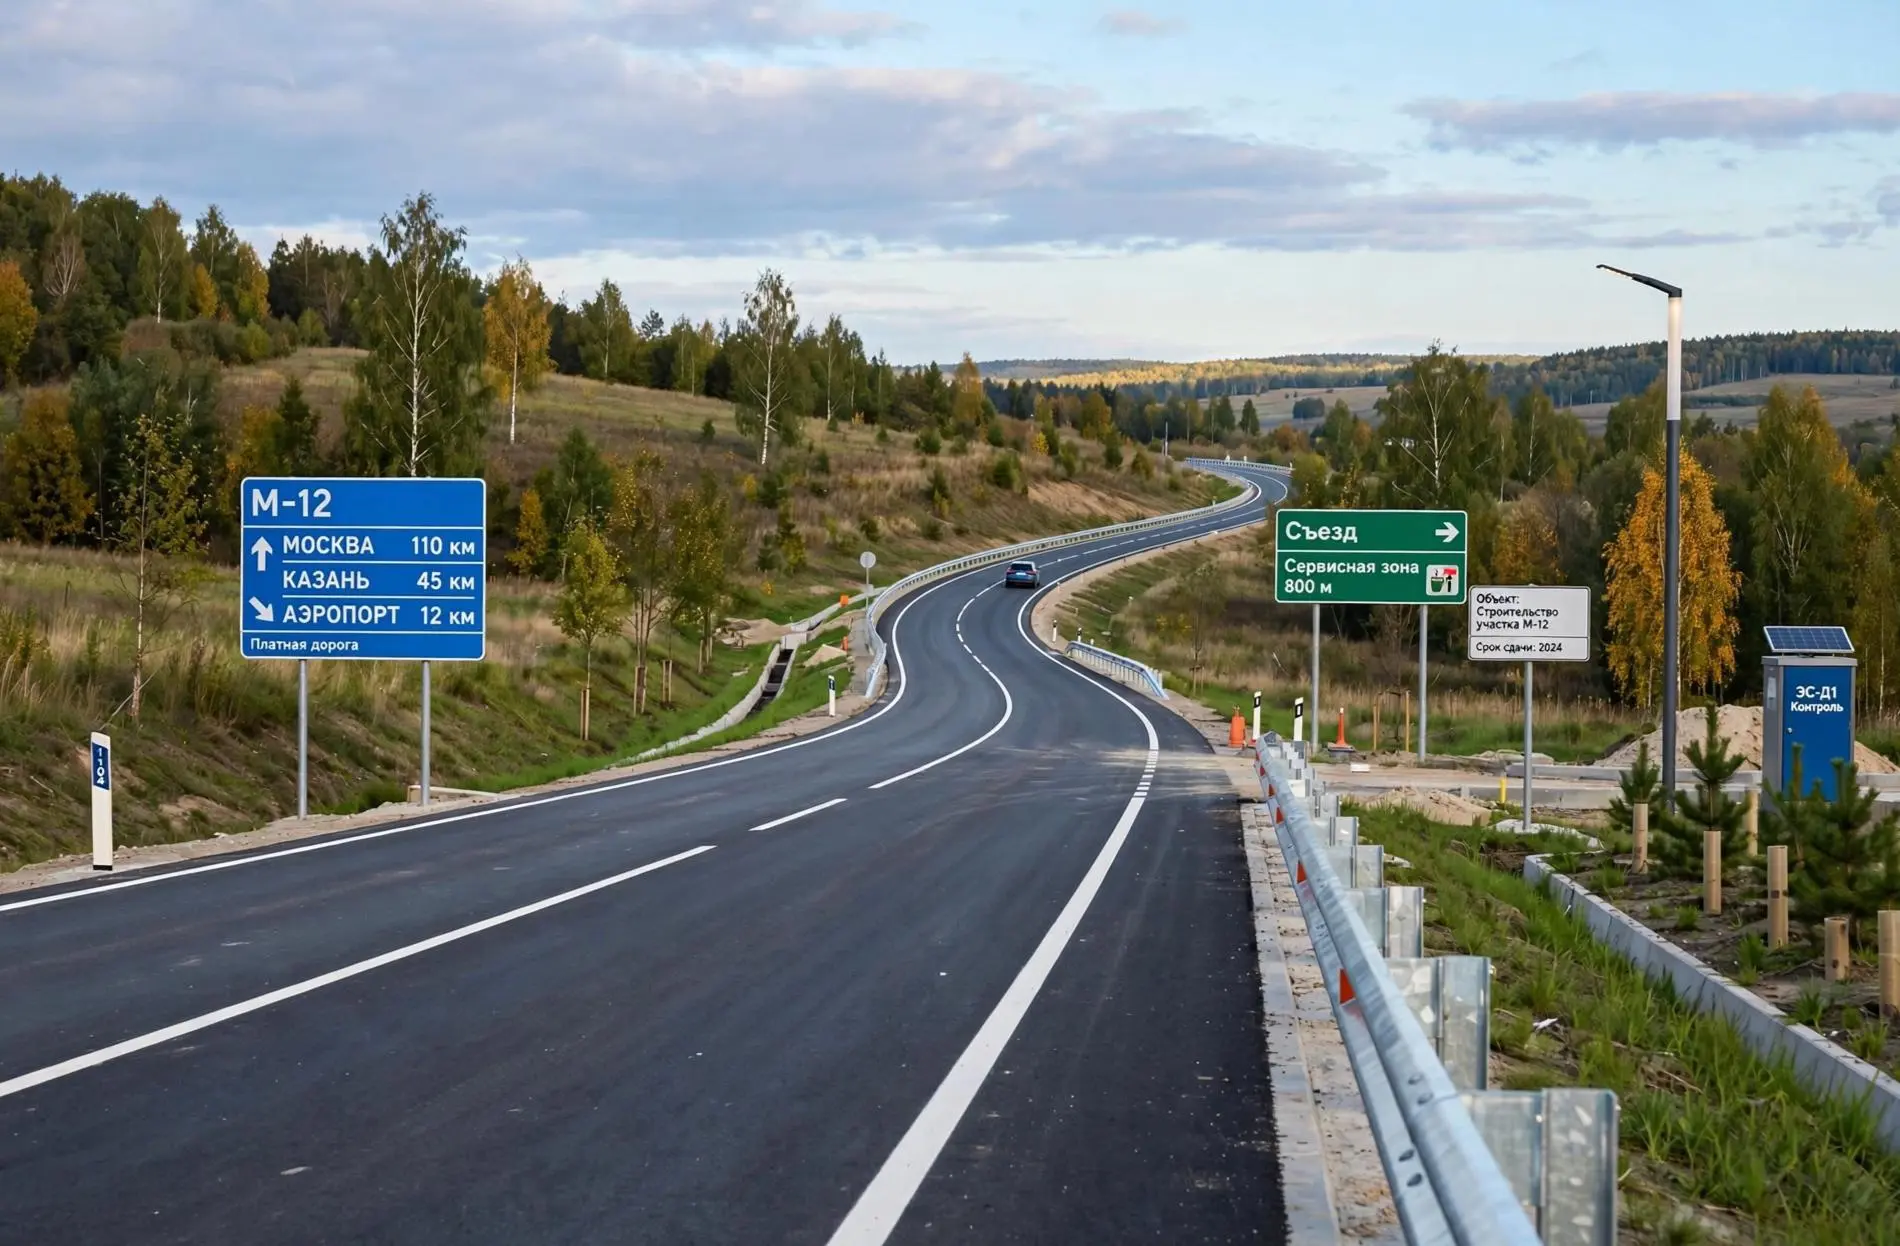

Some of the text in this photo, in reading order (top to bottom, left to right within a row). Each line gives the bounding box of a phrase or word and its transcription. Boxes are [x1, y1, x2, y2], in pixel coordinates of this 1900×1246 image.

[253, 489, 331, 517] М-12
[1286, 521, 1357, 543] Съезд
[284, 536, 475, 554] МОСКВА 110 км
[1285, 558, 1420, 576] Сервисная зона
[284, 571, 475, 589] КАЗАНЬ 45 км
[1285, 579, 1332, 593] 800 м
[1477, 593, 1520, 603] Объект:
[283, 605, 475, 624] АЭРОПОРТ 12 км
[1477, 606, 1559, 619] Строительство
[1476, 619, 1549, 631] участка М-12
[251, 638, 359, 653] Платная дорога
[1476, 642, 1563, 653] Срок сдачи: 2024
[1796, 686, 1836, 700] ЭС-Д1
[1791, 702, 1844, 714] Контроль
